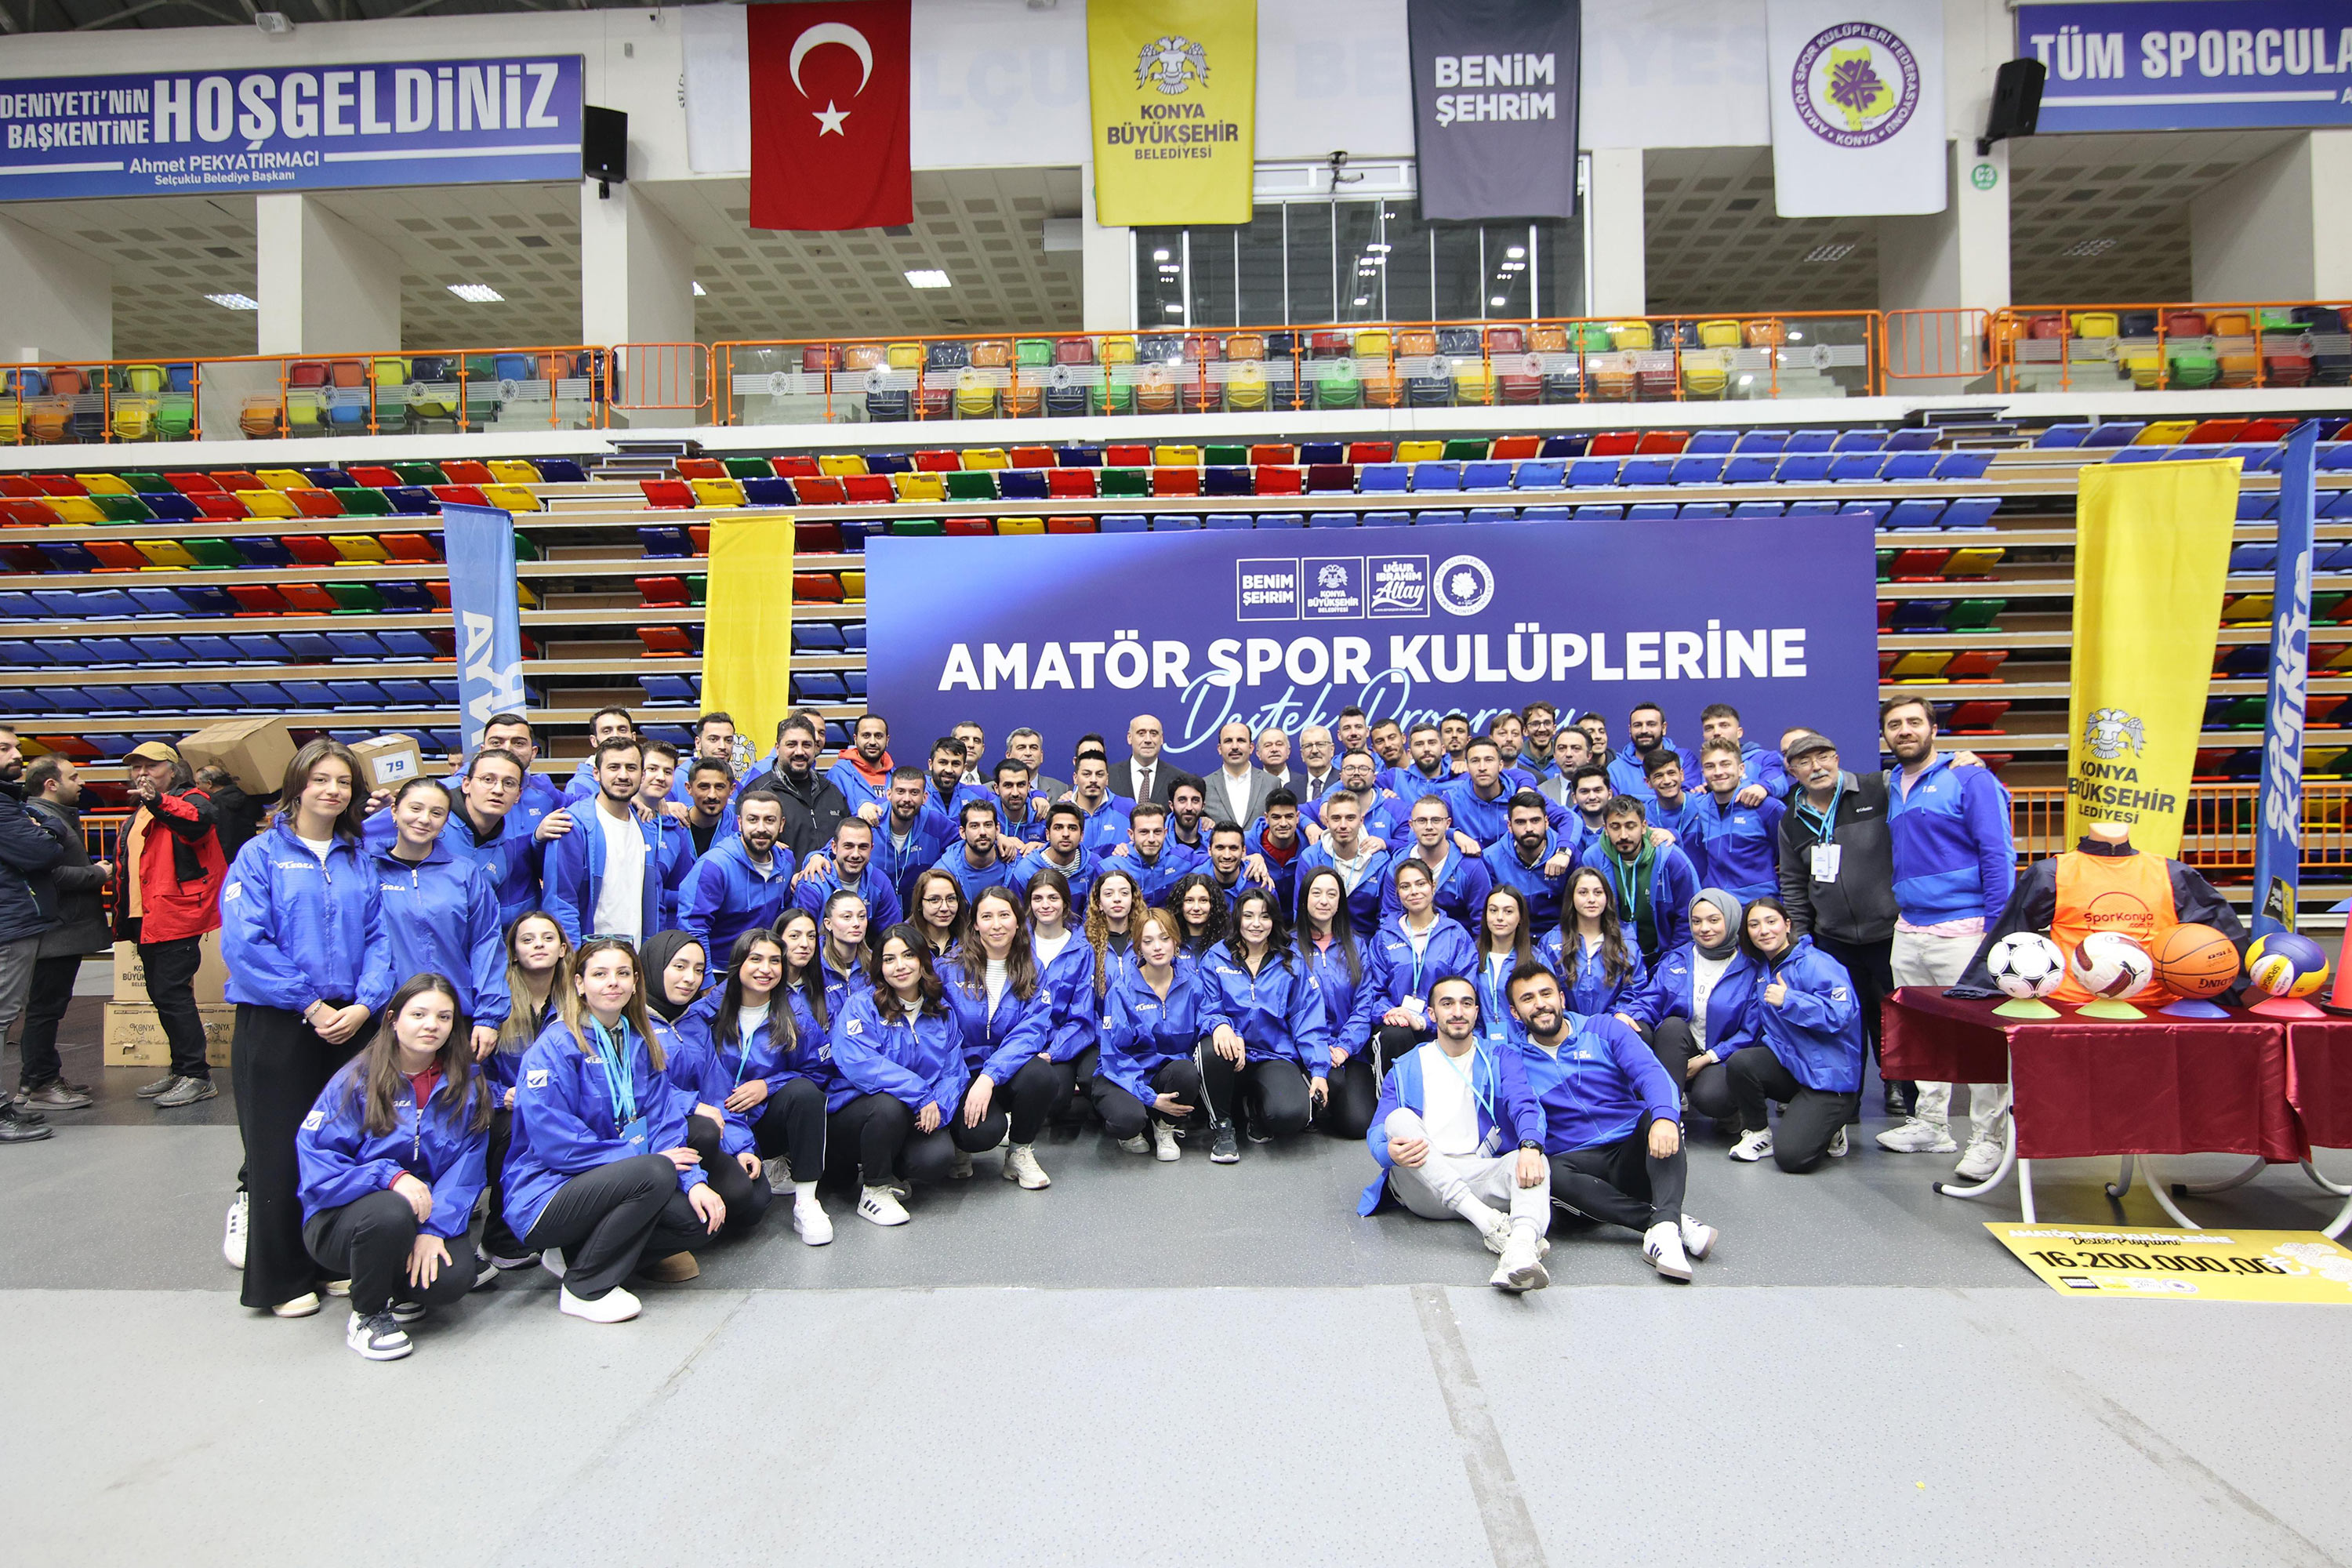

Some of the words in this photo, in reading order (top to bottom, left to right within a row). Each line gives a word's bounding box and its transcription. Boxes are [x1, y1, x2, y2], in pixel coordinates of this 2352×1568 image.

[2031, 25, 2124, 80] TÜM
[1795, 45, 1818, 82] SPOR
[1140, 103, 1206, 120] KONYA
[1107, 122, 1239, 147] BÜYÜKŞEHİR
[1835, 133, 1878, 147] KONYA
[129, 157, 185, 174] Ahmet
[154, 172, 201, 187] Selçuklu
[204, 171, 250, 185] Belediye
[252, 170, 295, 183] Başkanı
[1382, 561, 1414, 573] UĞUR
[1319, 590, 1346, 598] KONYA
[1372, 581, 1425, 608] Altay
[938, 630, 1190, 691] AMATÖR
[1207, 635, 1371, 687] SPOR
[1389, 619, 1807, 684] KULÜPLERİNE
[386, 760, 405, 773] 79
[2083, 912, 2154, 925] SporKonya
